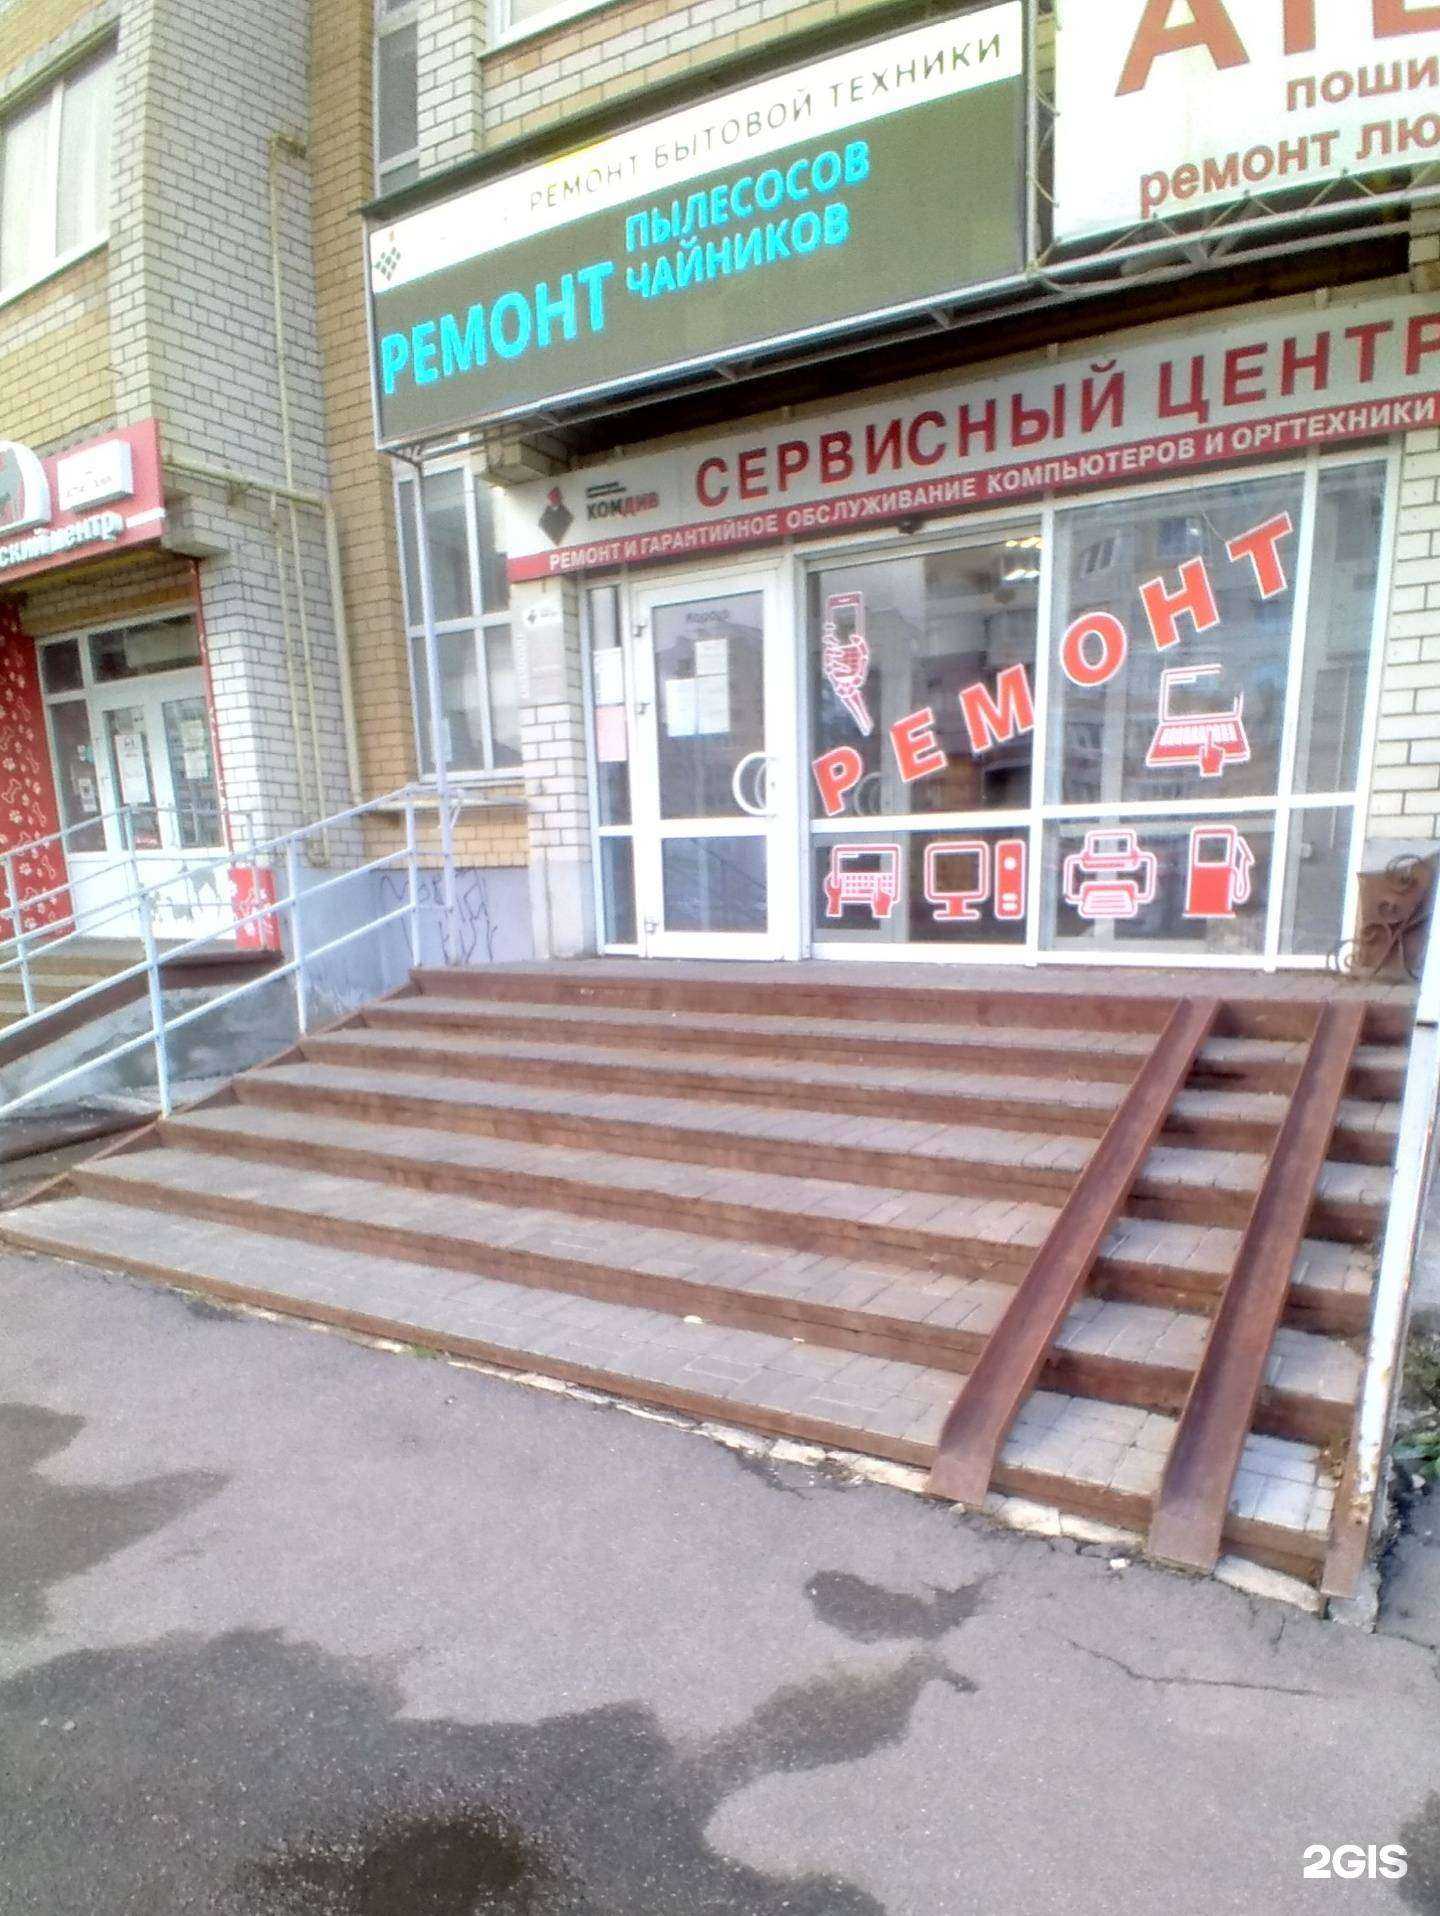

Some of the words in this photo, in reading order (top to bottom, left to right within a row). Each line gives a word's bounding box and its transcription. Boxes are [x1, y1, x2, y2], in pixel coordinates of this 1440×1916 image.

[530, 155, 639, 212] РЕМОНТ
[655, 88, 812, 168] БЫТОВОЙ
[830, 33, 1000, 108] ТЕХНИКИ
[1286, 56, 1440, 111] поши
[625, 140, 870, 252] ПЫЛЕСОСОВ
[1140, 130, 1340, 219] ремонт
[625, 202, 850, 298] ЧАЙНИКОВ
[380, 260, 615, 395] РЕМОНТ
[695, 359, 1126, 508] СЕРВИСНЫЙ
[1157, 312, 1440, 424] ЦЕНТР
[549, 542, 621, 571] РЕМОНТ
[623, 540, 638, 558] И
[639, 514, 779, 554] ГАРАНТИЙНОЕ
[785, 477, 977, 529] ОБСЛУЖИВАНИЕ
[987, 437, 1195, 494] КОМПЬЮТЕРОВ
[1205, 431, 1223, 454] И
[1231, 397, 1435, 450] ОРГТЕХНИКИ
[812, 511, 1294, 817] РЕМОНТ
